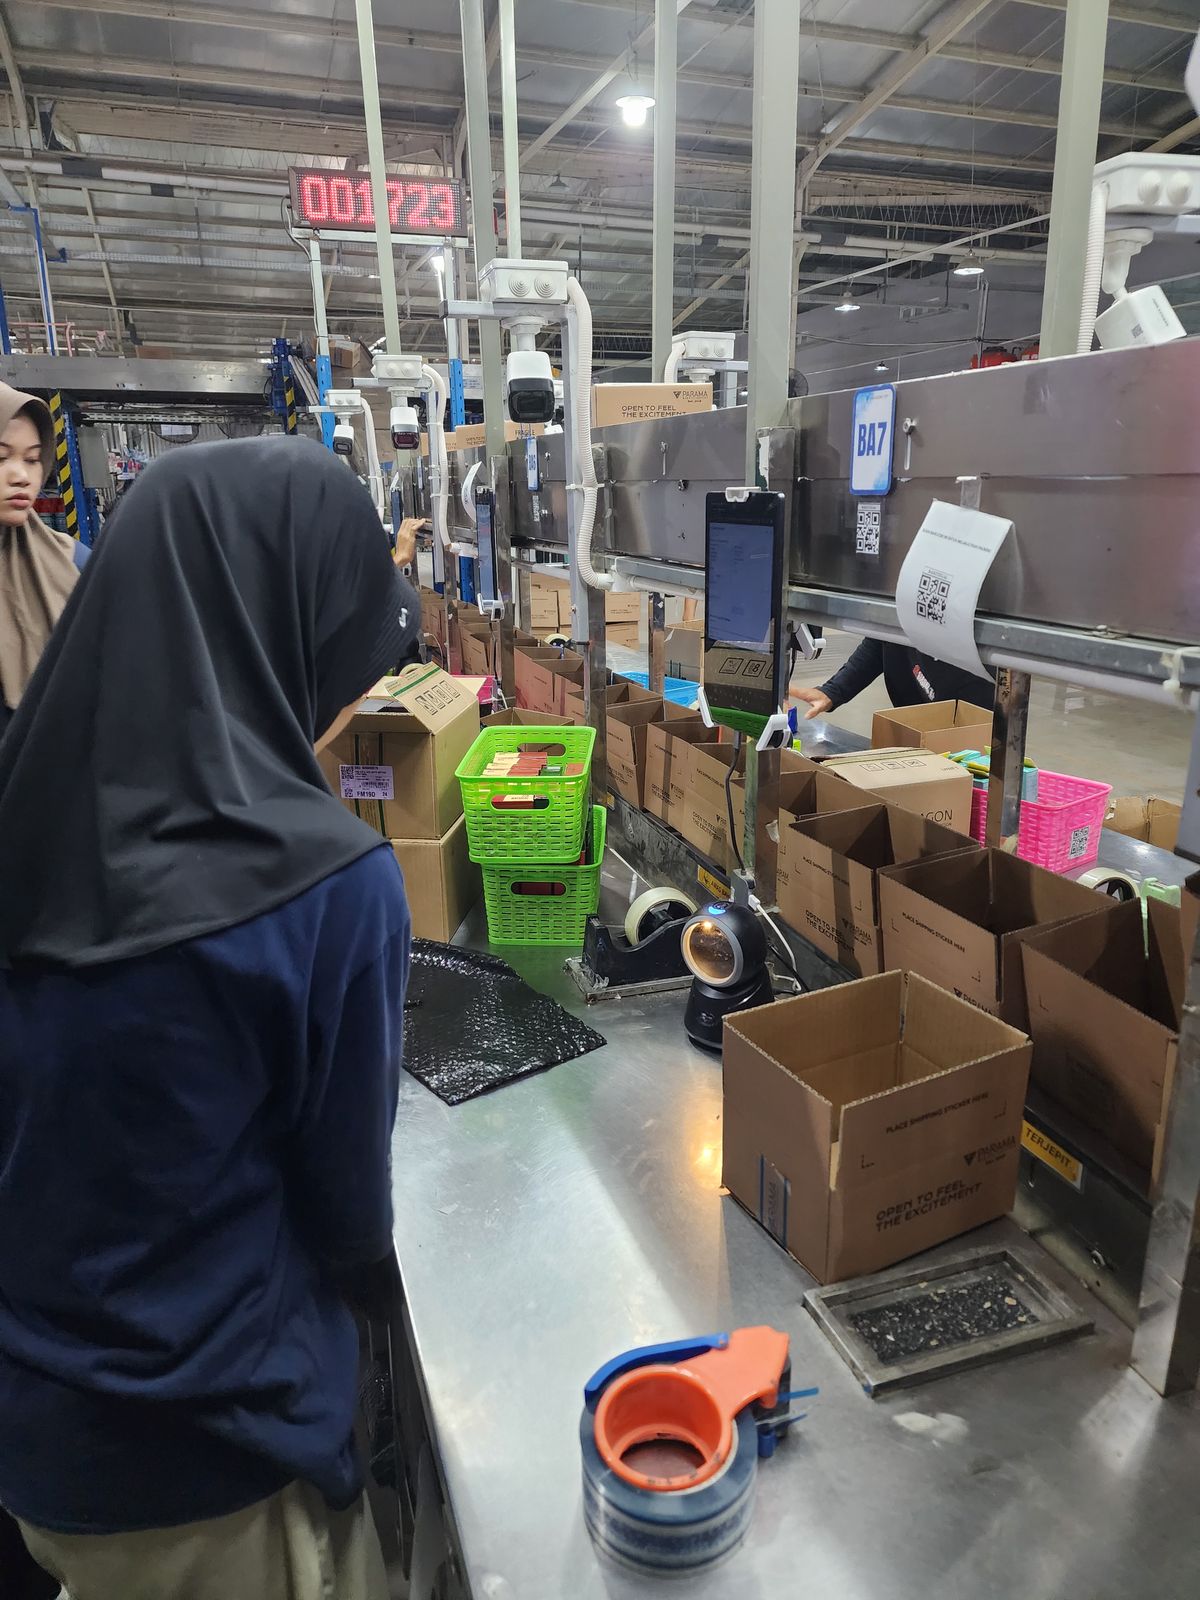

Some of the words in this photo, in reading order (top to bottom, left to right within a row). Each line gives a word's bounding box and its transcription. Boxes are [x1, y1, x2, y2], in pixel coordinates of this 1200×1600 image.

[302, 176, 454, 228] 001723
[682, 390, 708, 398] PARAMA
[857, 421, 888, 457] BA7
[921, 809, 953, 823] GON
[805, 909, 821, 925] OPEN
[885, 1121, 909, 1134] PLACE
[909, 1108, 943, 1127] SHIPPING
[943, 1098, 971, 1114] STICKER
[971, 1091, 989, 1104] HERE
[1025, 1127, 1072, 1168] TERJEPIT
[876, 1200, 913, 1222] OPEN
[916, 1191, 934, 1204] TO
[936, 1179, 966, 1195] FEEL
[876, 1215, 901, 1233] THE
[904, 1181, 983, 1222] EXCITEMENT
